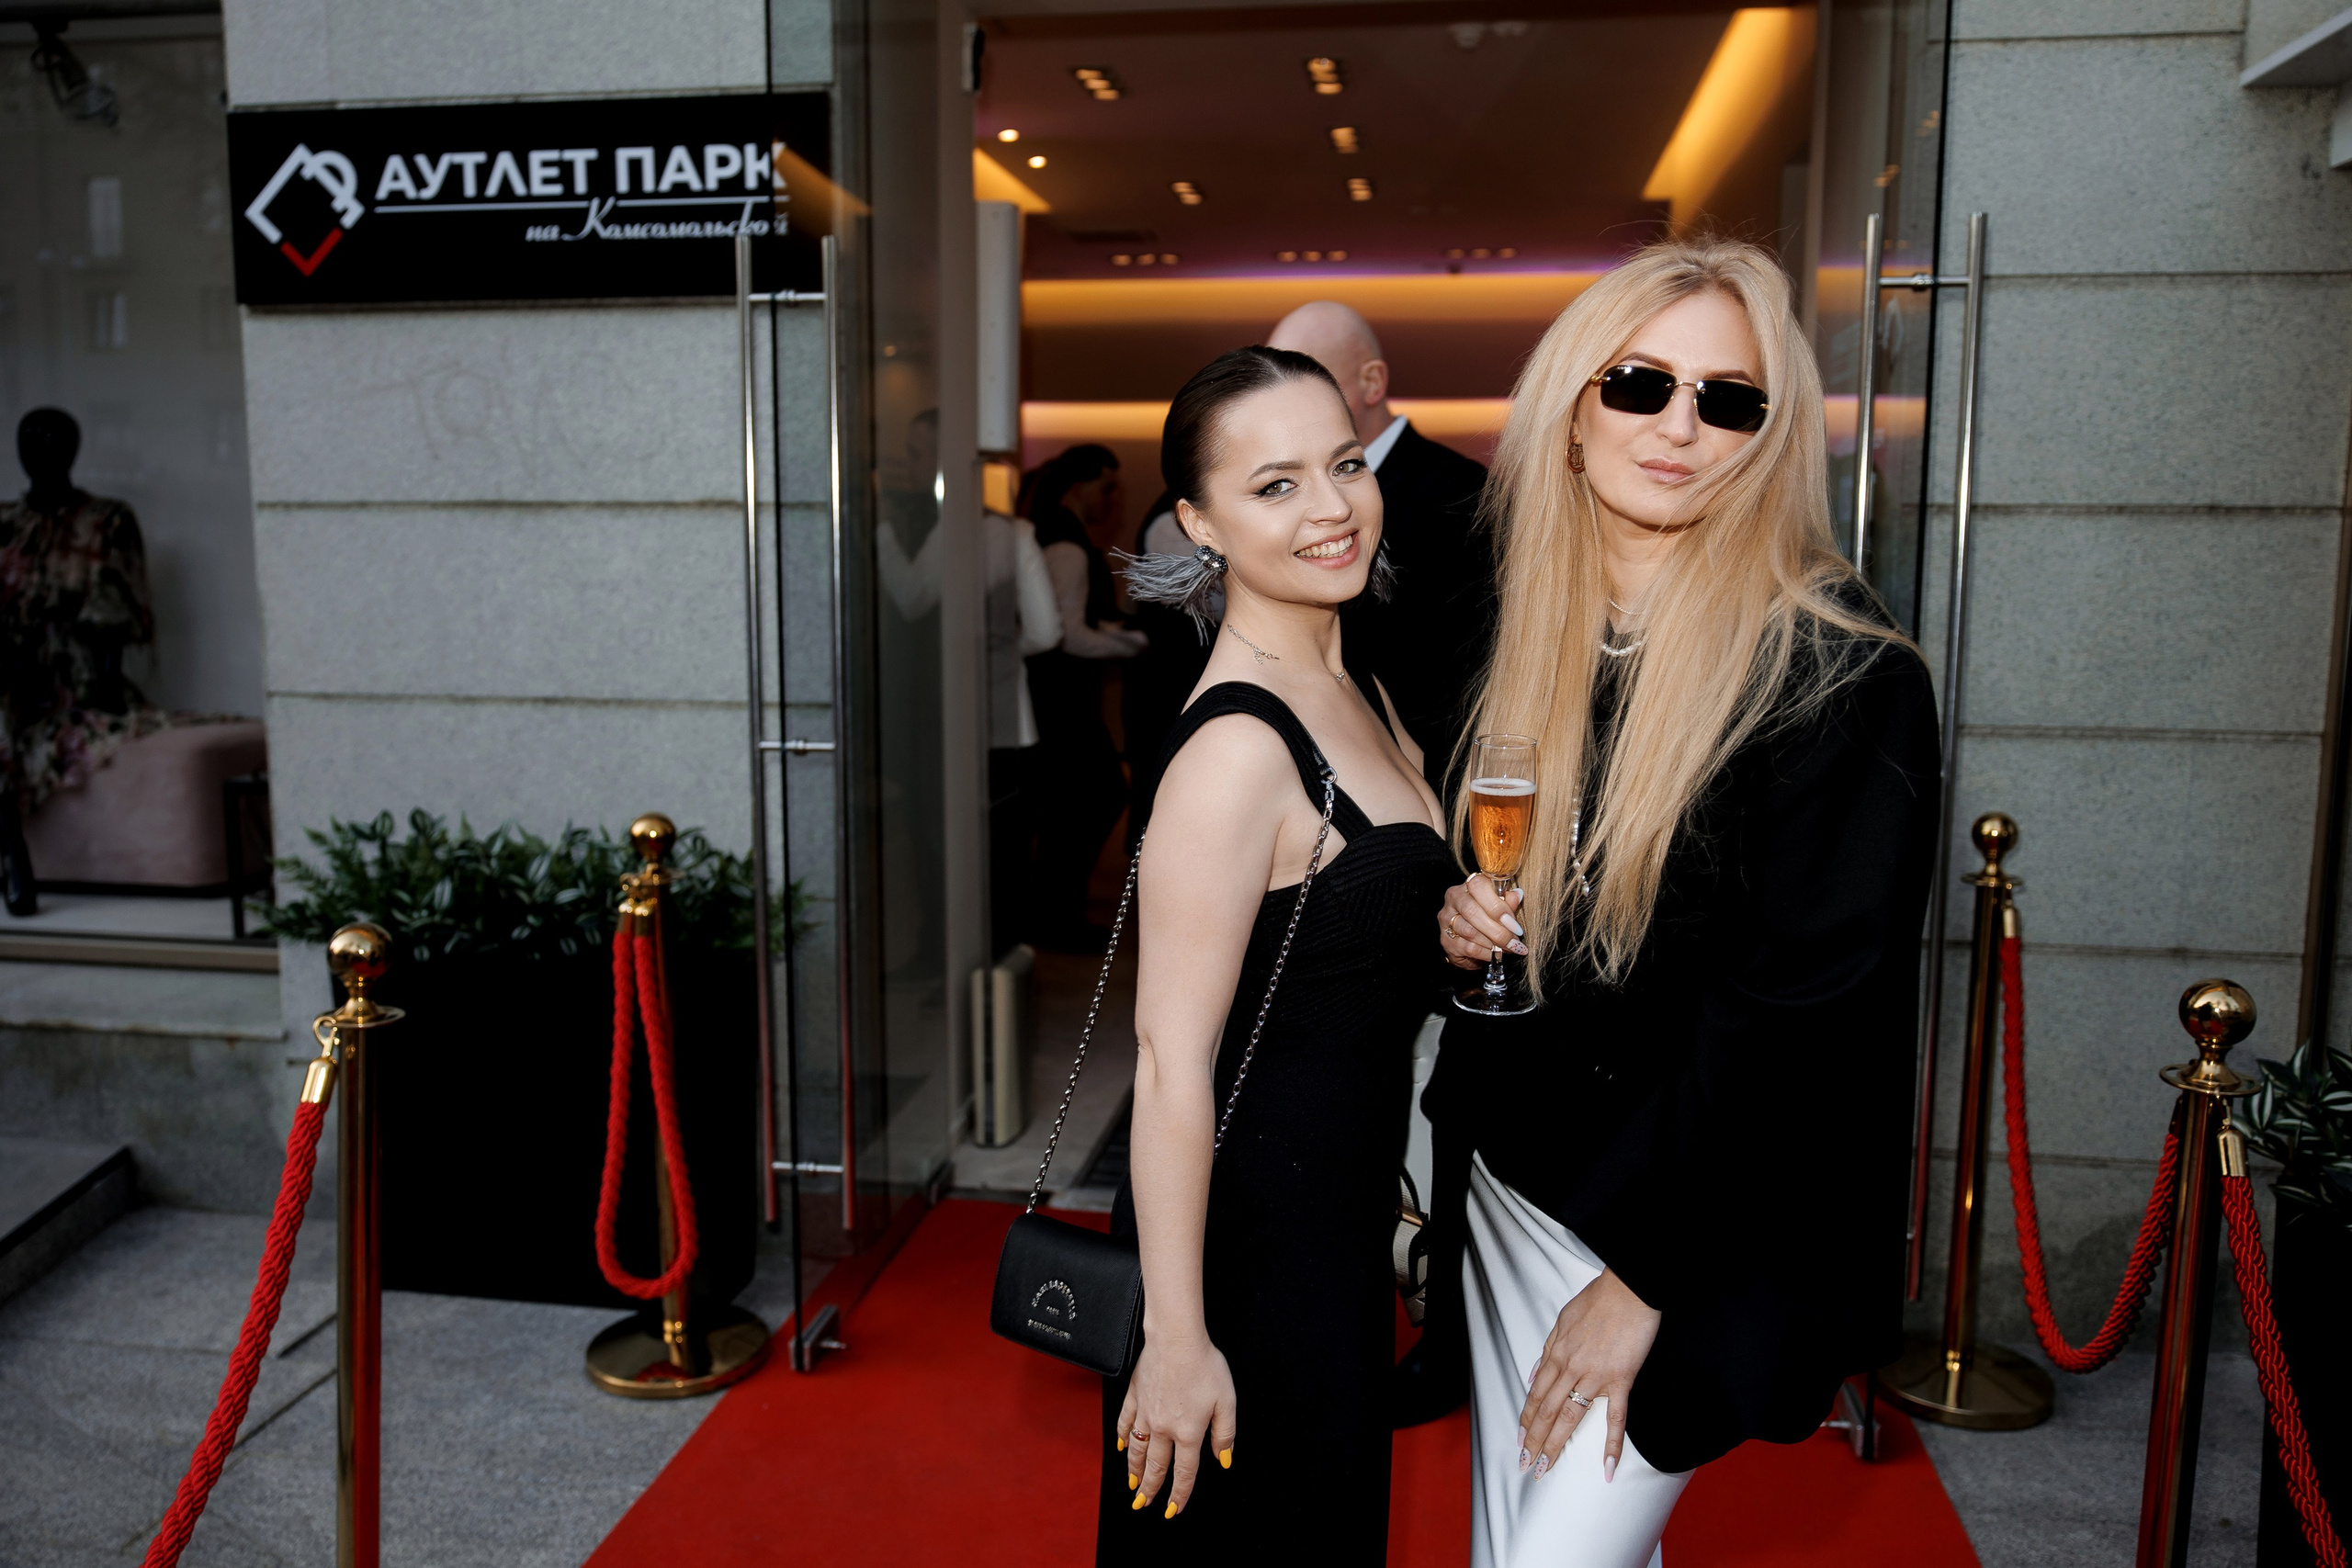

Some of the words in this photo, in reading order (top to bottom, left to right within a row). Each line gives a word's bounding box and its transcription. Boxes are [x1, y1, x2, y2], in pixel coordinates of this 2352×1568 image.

[374, 147, 599, 200] АУТЛЕТ
[614, 141, 787, 192] ПАРК
[525, 224, 560, 243] на
